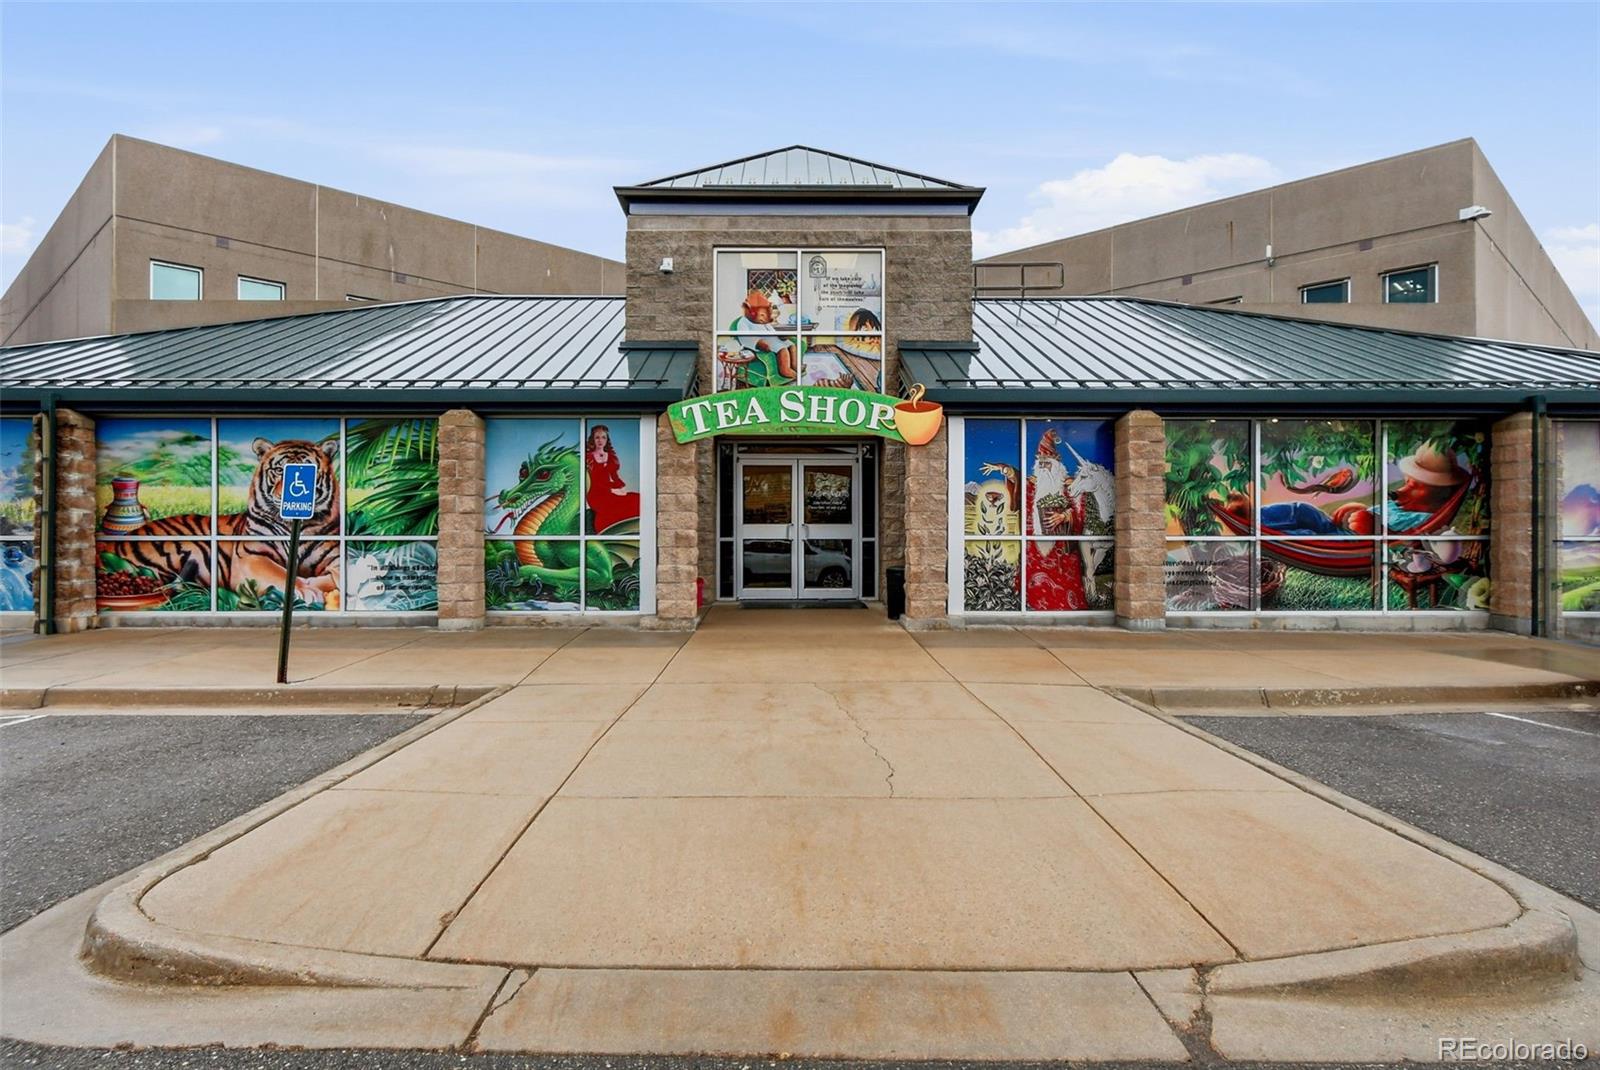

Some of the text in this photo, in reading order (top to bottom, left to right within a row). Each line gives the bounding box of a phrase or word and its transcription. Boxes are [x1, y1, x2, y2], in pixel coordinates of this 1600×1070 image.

[682, 390, 896, 435] TEA SHOP
[283, 501, 312, 511] PARKING
